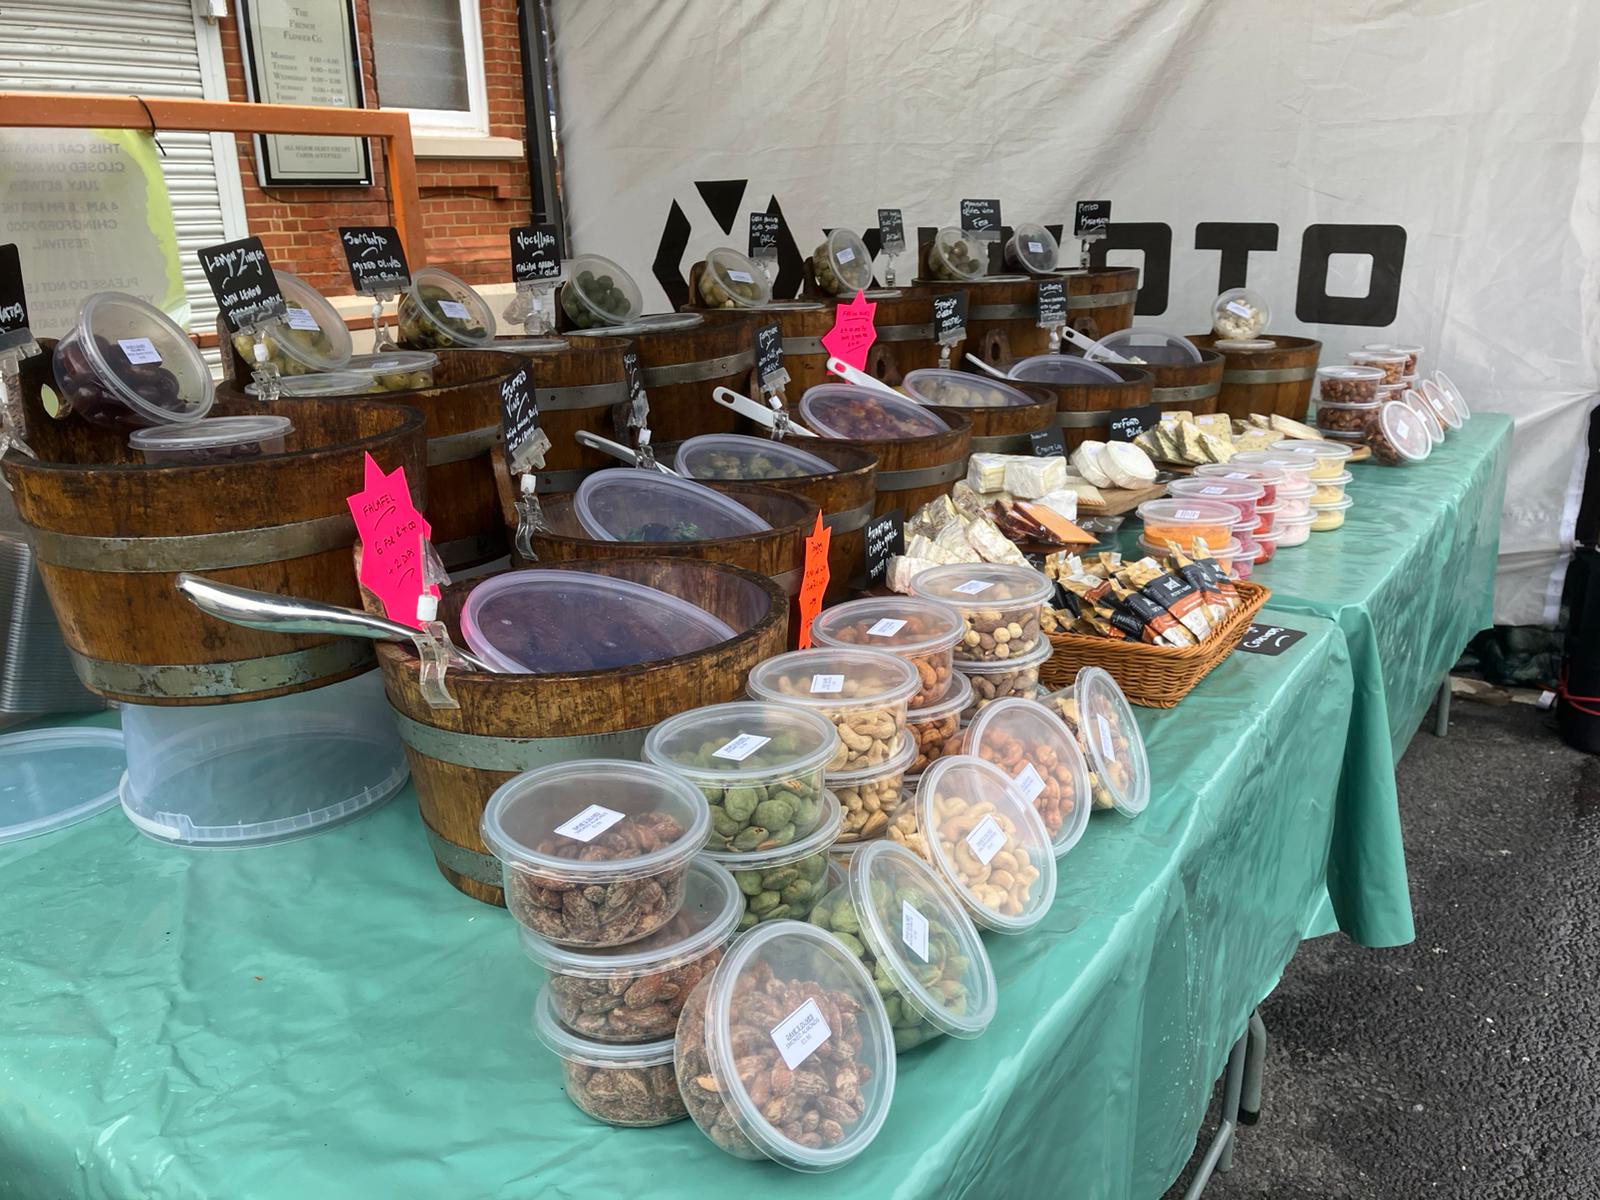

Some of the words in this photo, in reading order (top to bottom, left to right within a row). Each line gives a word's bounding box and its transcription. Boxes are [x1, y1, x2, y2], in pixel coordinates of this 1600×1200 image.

[352, 260, 377, 277] MIXED
[239, 284, 262, 300] LEMON
[374, 541, 384, 555] 6
